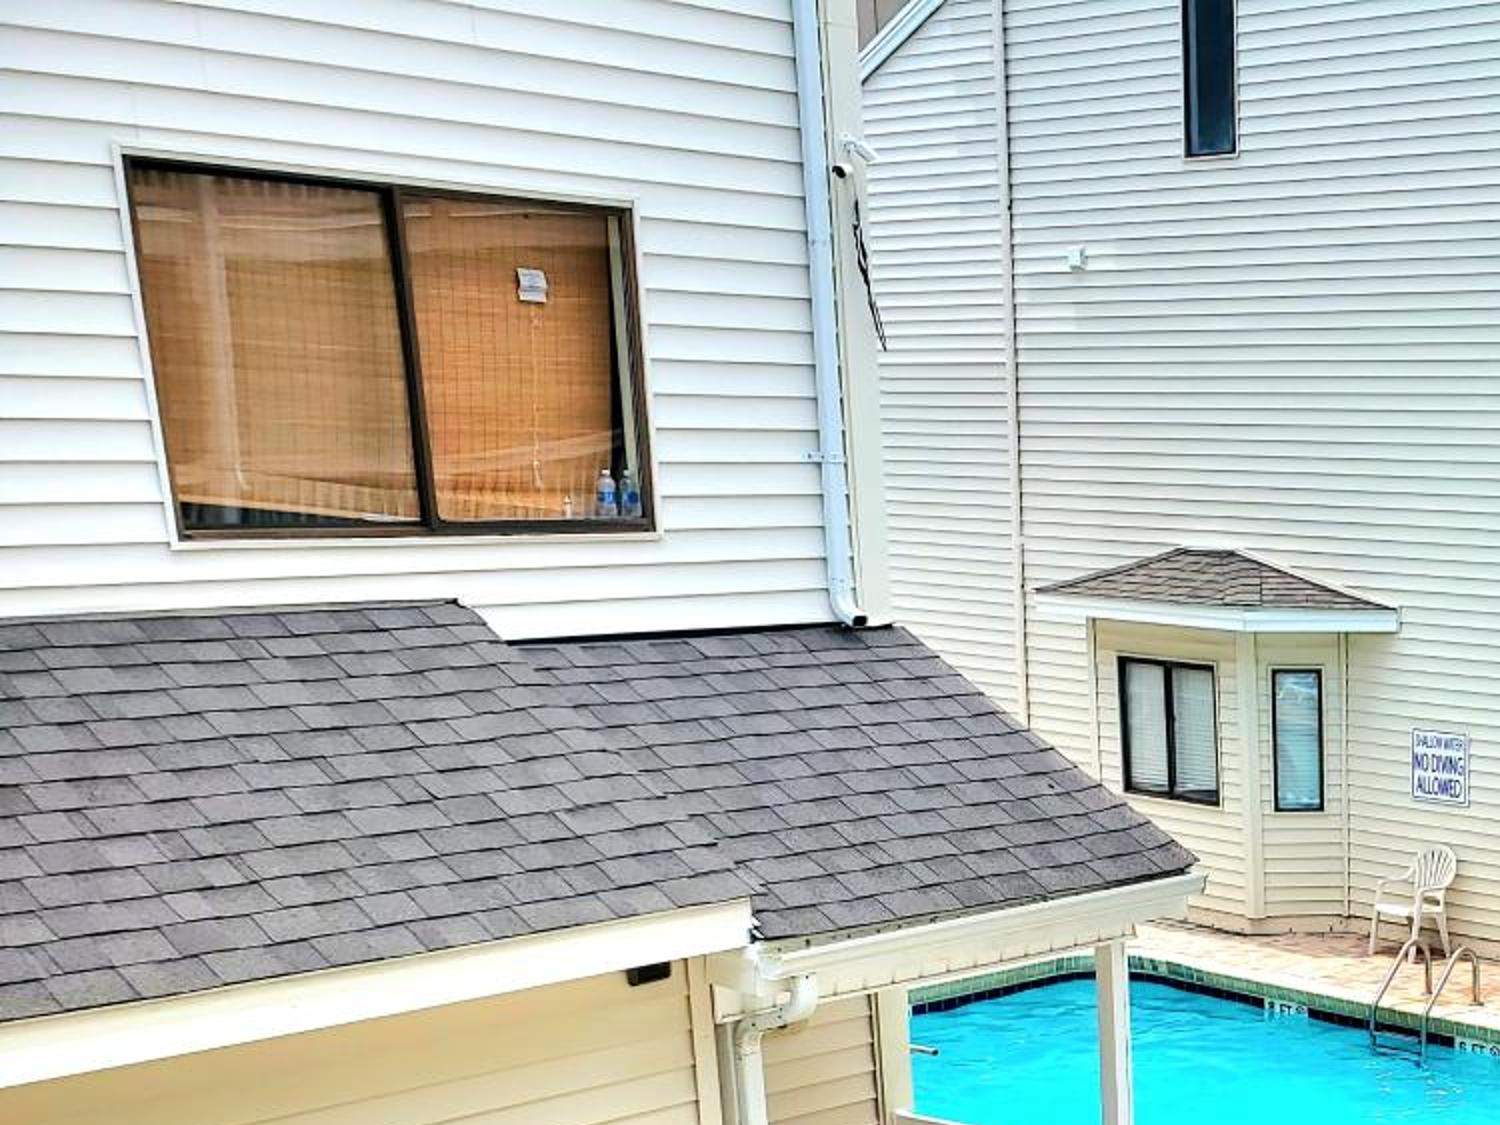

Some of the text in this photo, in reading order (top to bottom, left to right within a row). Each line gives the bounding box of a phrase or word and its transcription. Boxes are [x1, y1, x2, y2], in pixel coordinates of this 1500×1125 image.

[1415, 752, 1463, 776] NO DIVING
[1416, 775, 1462, 798] ALLOWED
